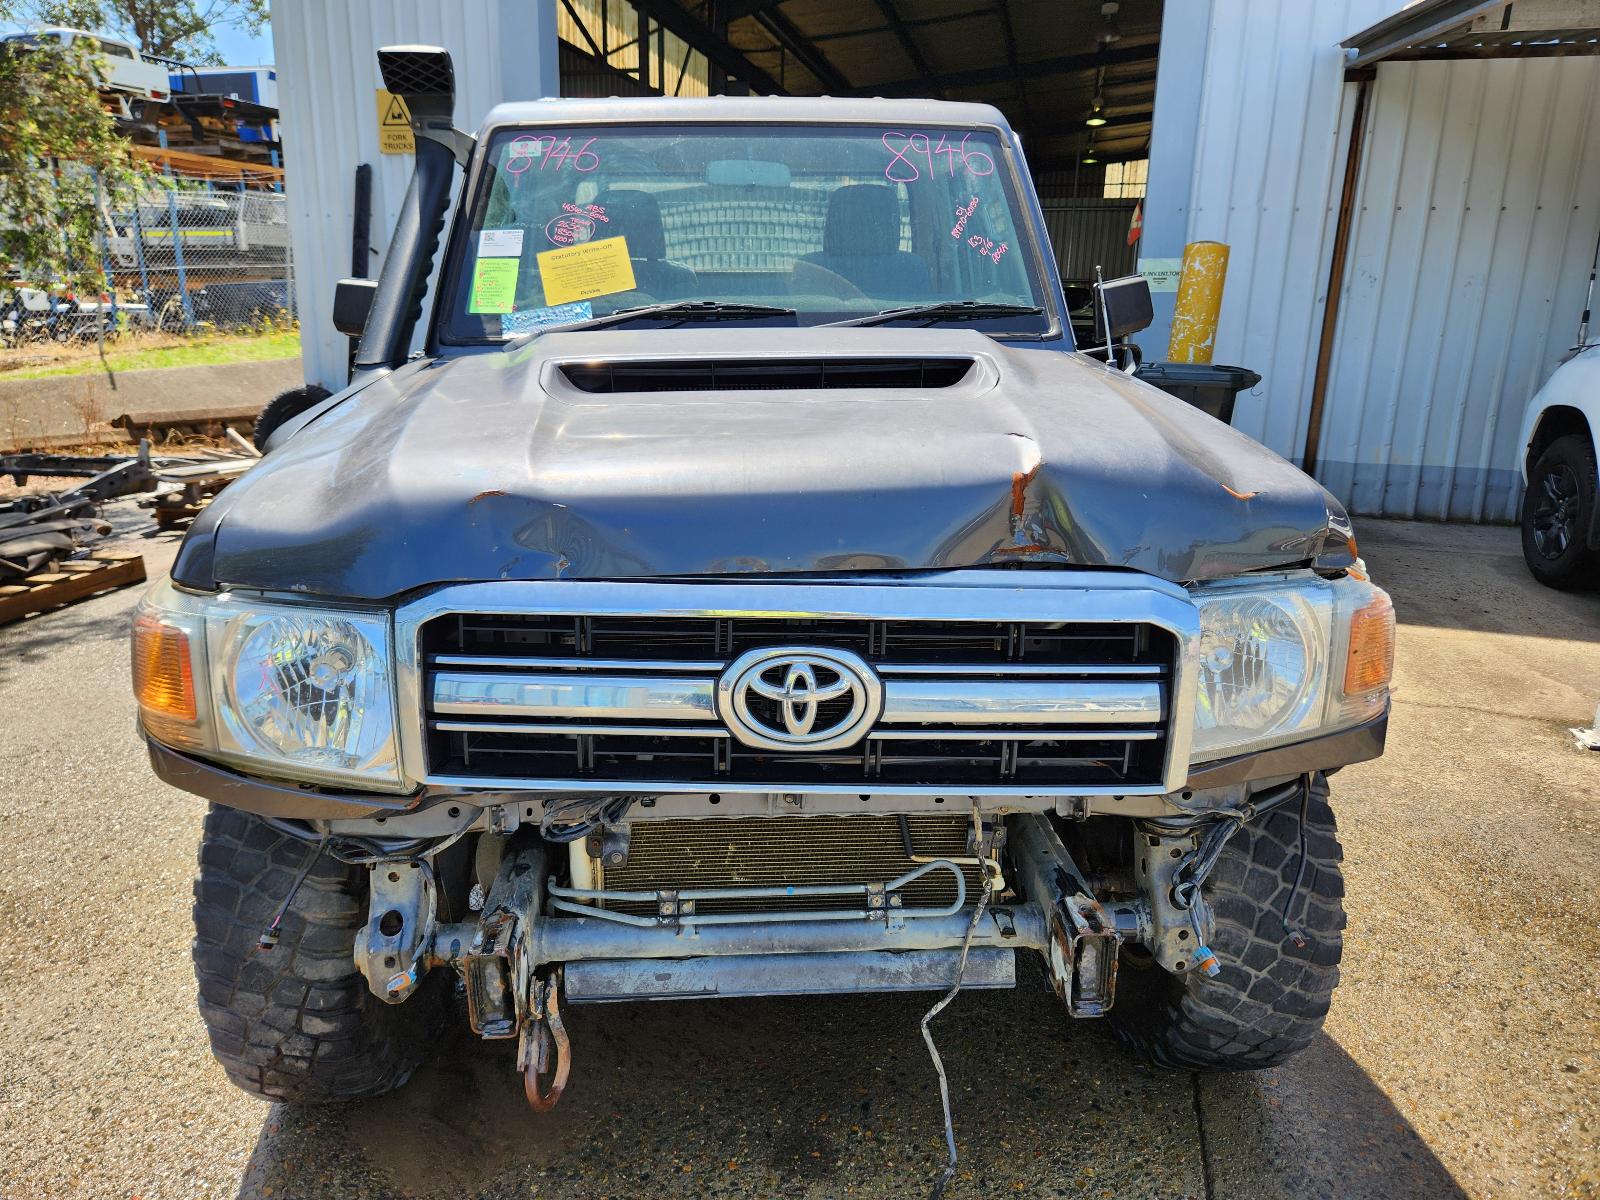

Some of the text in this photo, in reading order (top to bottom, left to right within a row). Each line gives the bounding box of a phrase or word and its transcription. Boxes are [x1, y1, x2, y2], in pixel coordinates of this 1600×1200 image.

[387, 134, 408, 142] FORK
[384, 143, 414, 151] TRUCKS
[506, 135, 600, 173] 8946
[882, 132, 994, 182] 8946
[585, 204, 606, 214] ABS
[551, 251, 581, 260] Statutory
